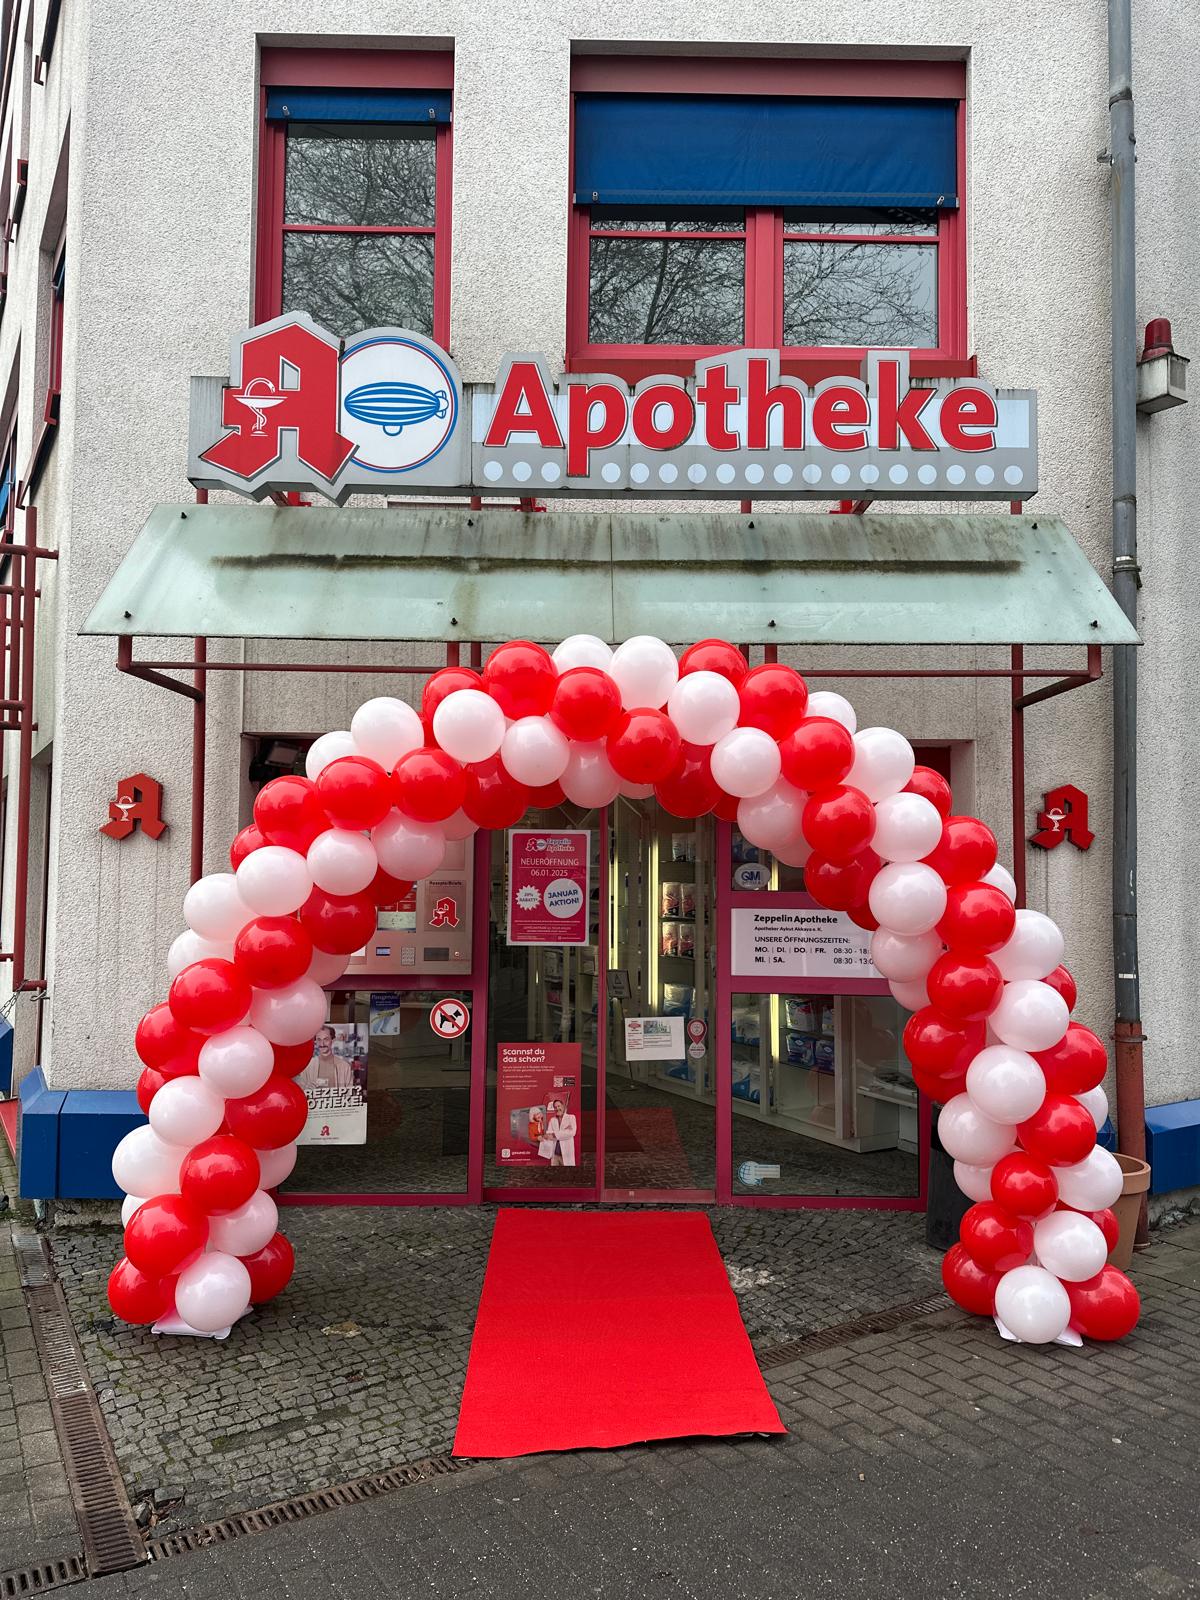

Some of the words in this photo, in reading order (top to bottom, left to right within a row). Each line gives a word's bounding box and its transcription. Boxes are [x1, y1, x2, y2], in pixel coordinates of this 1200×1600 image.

[484, 356, 999, 477] Apotheke
[530, 869, 569, 877] 06.01.2025
[547, 889, 579, 899] JANUAR
[549, 898, 580, 907] AKTION!
[754, 914, 793, 925] Zeppelin
[794, 915, 838, 925] Apotheke
[784, 935, 851, 944] ÖFFNUNGSZEITEN:
[503, 1048, 533, 1056] Scannst
[534, 1048, 545, 1056] du
[503, 1055, 517, 1063] das
[518, 1055, 545, 1063] schon?
[307, 1096, 364, 1109] OTHEKE!
